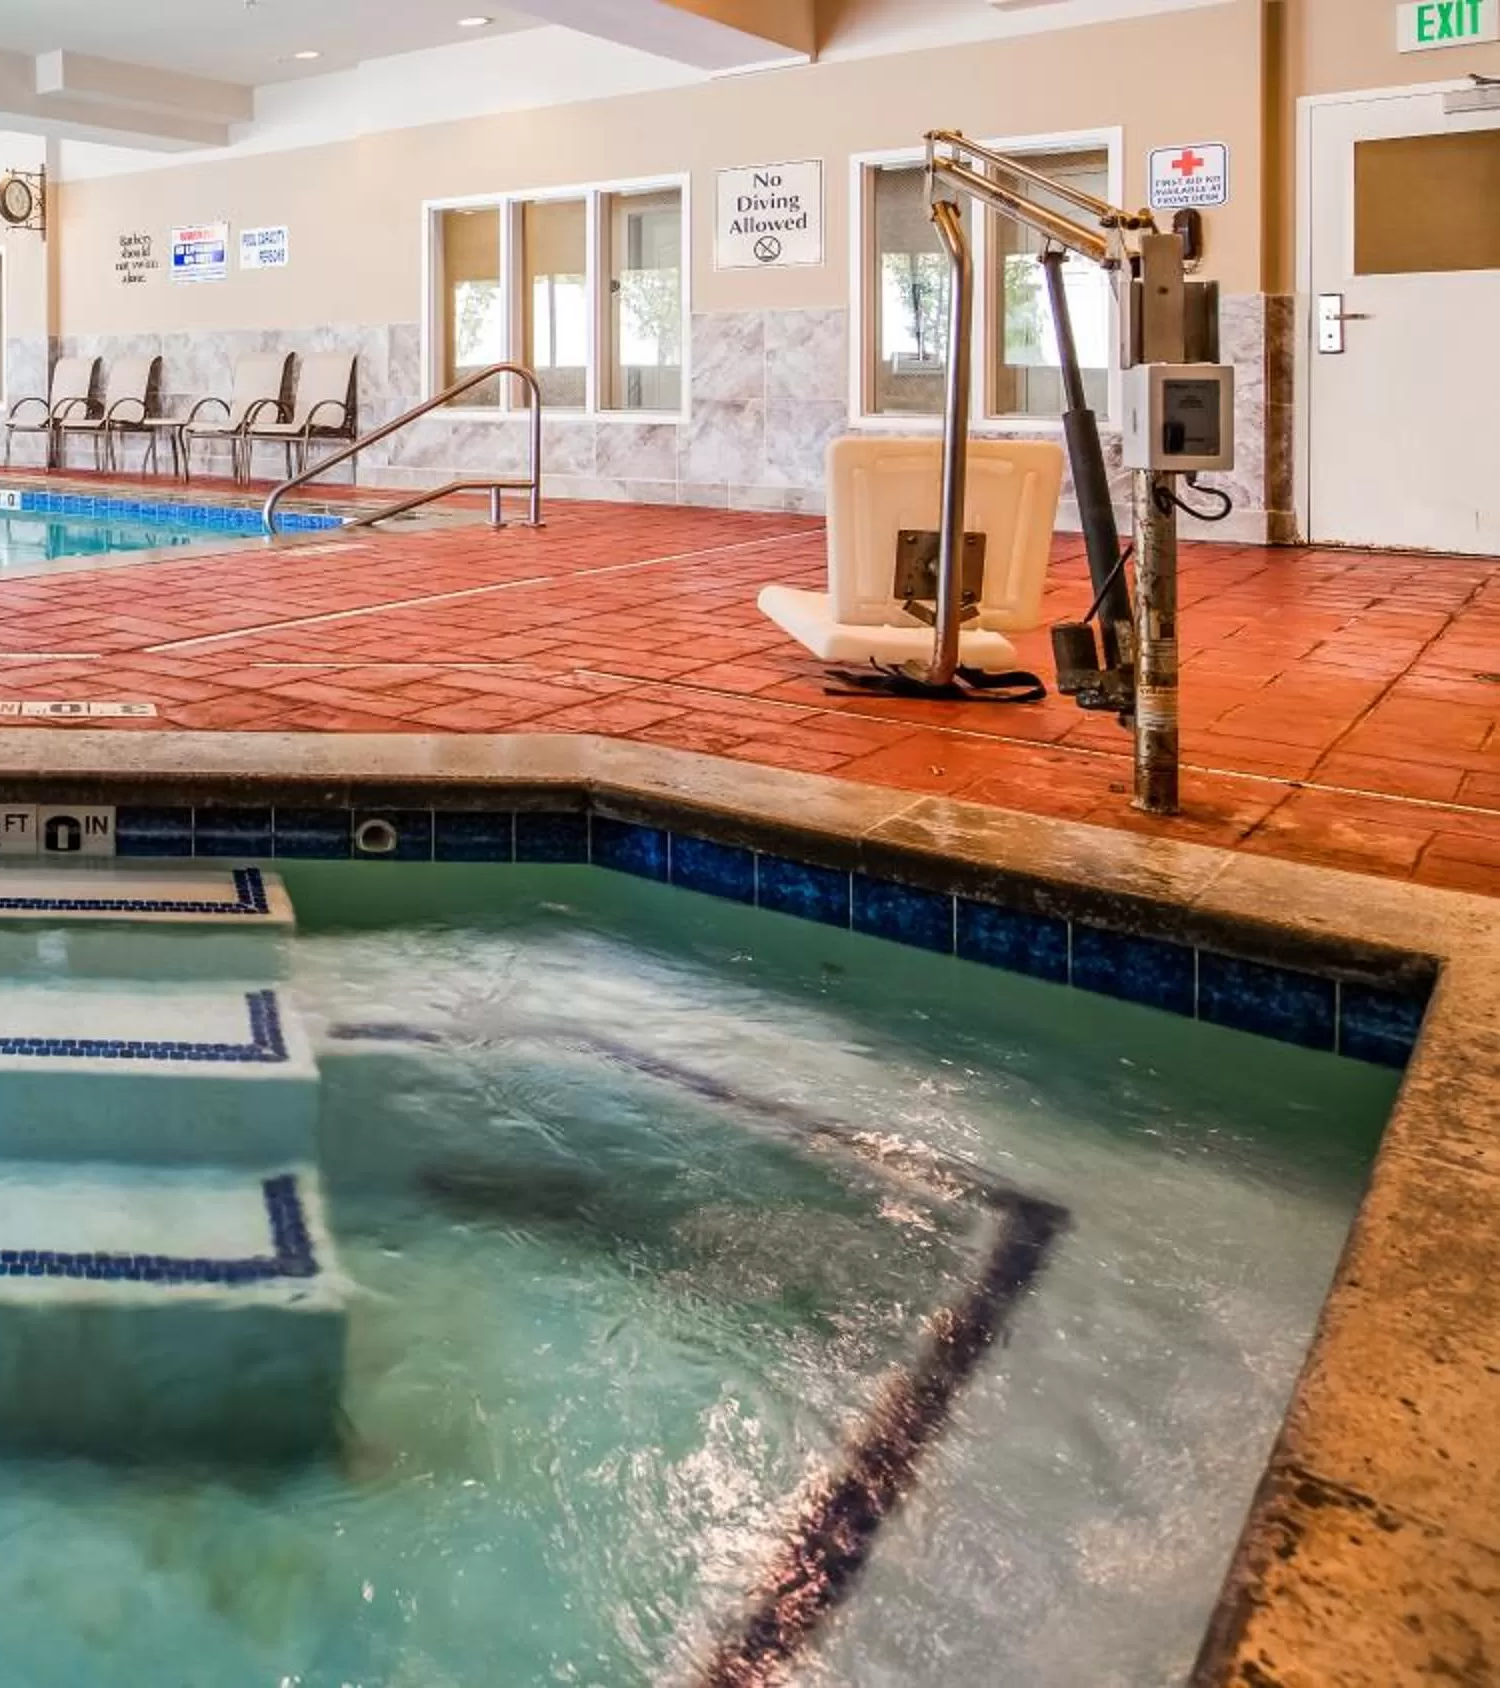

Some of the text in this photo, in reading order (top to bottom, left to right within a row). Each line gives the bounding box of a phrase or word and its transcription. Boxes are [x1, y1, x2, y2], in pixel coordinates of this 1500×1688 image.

[1417, 0, 1483, 42] EXIT
[753, 172, 782, 188] No
[1155, 178, 1184, 187] FIRST
[1185, 177, 1202, 185] AID
[737, 193, 800, 212] Diving
[729, 212, 807, 234] Allowed
[4, 813, 29, 832] FT
[45, 815, 81, 851] 0
[85, 815, 108, 835] IN
